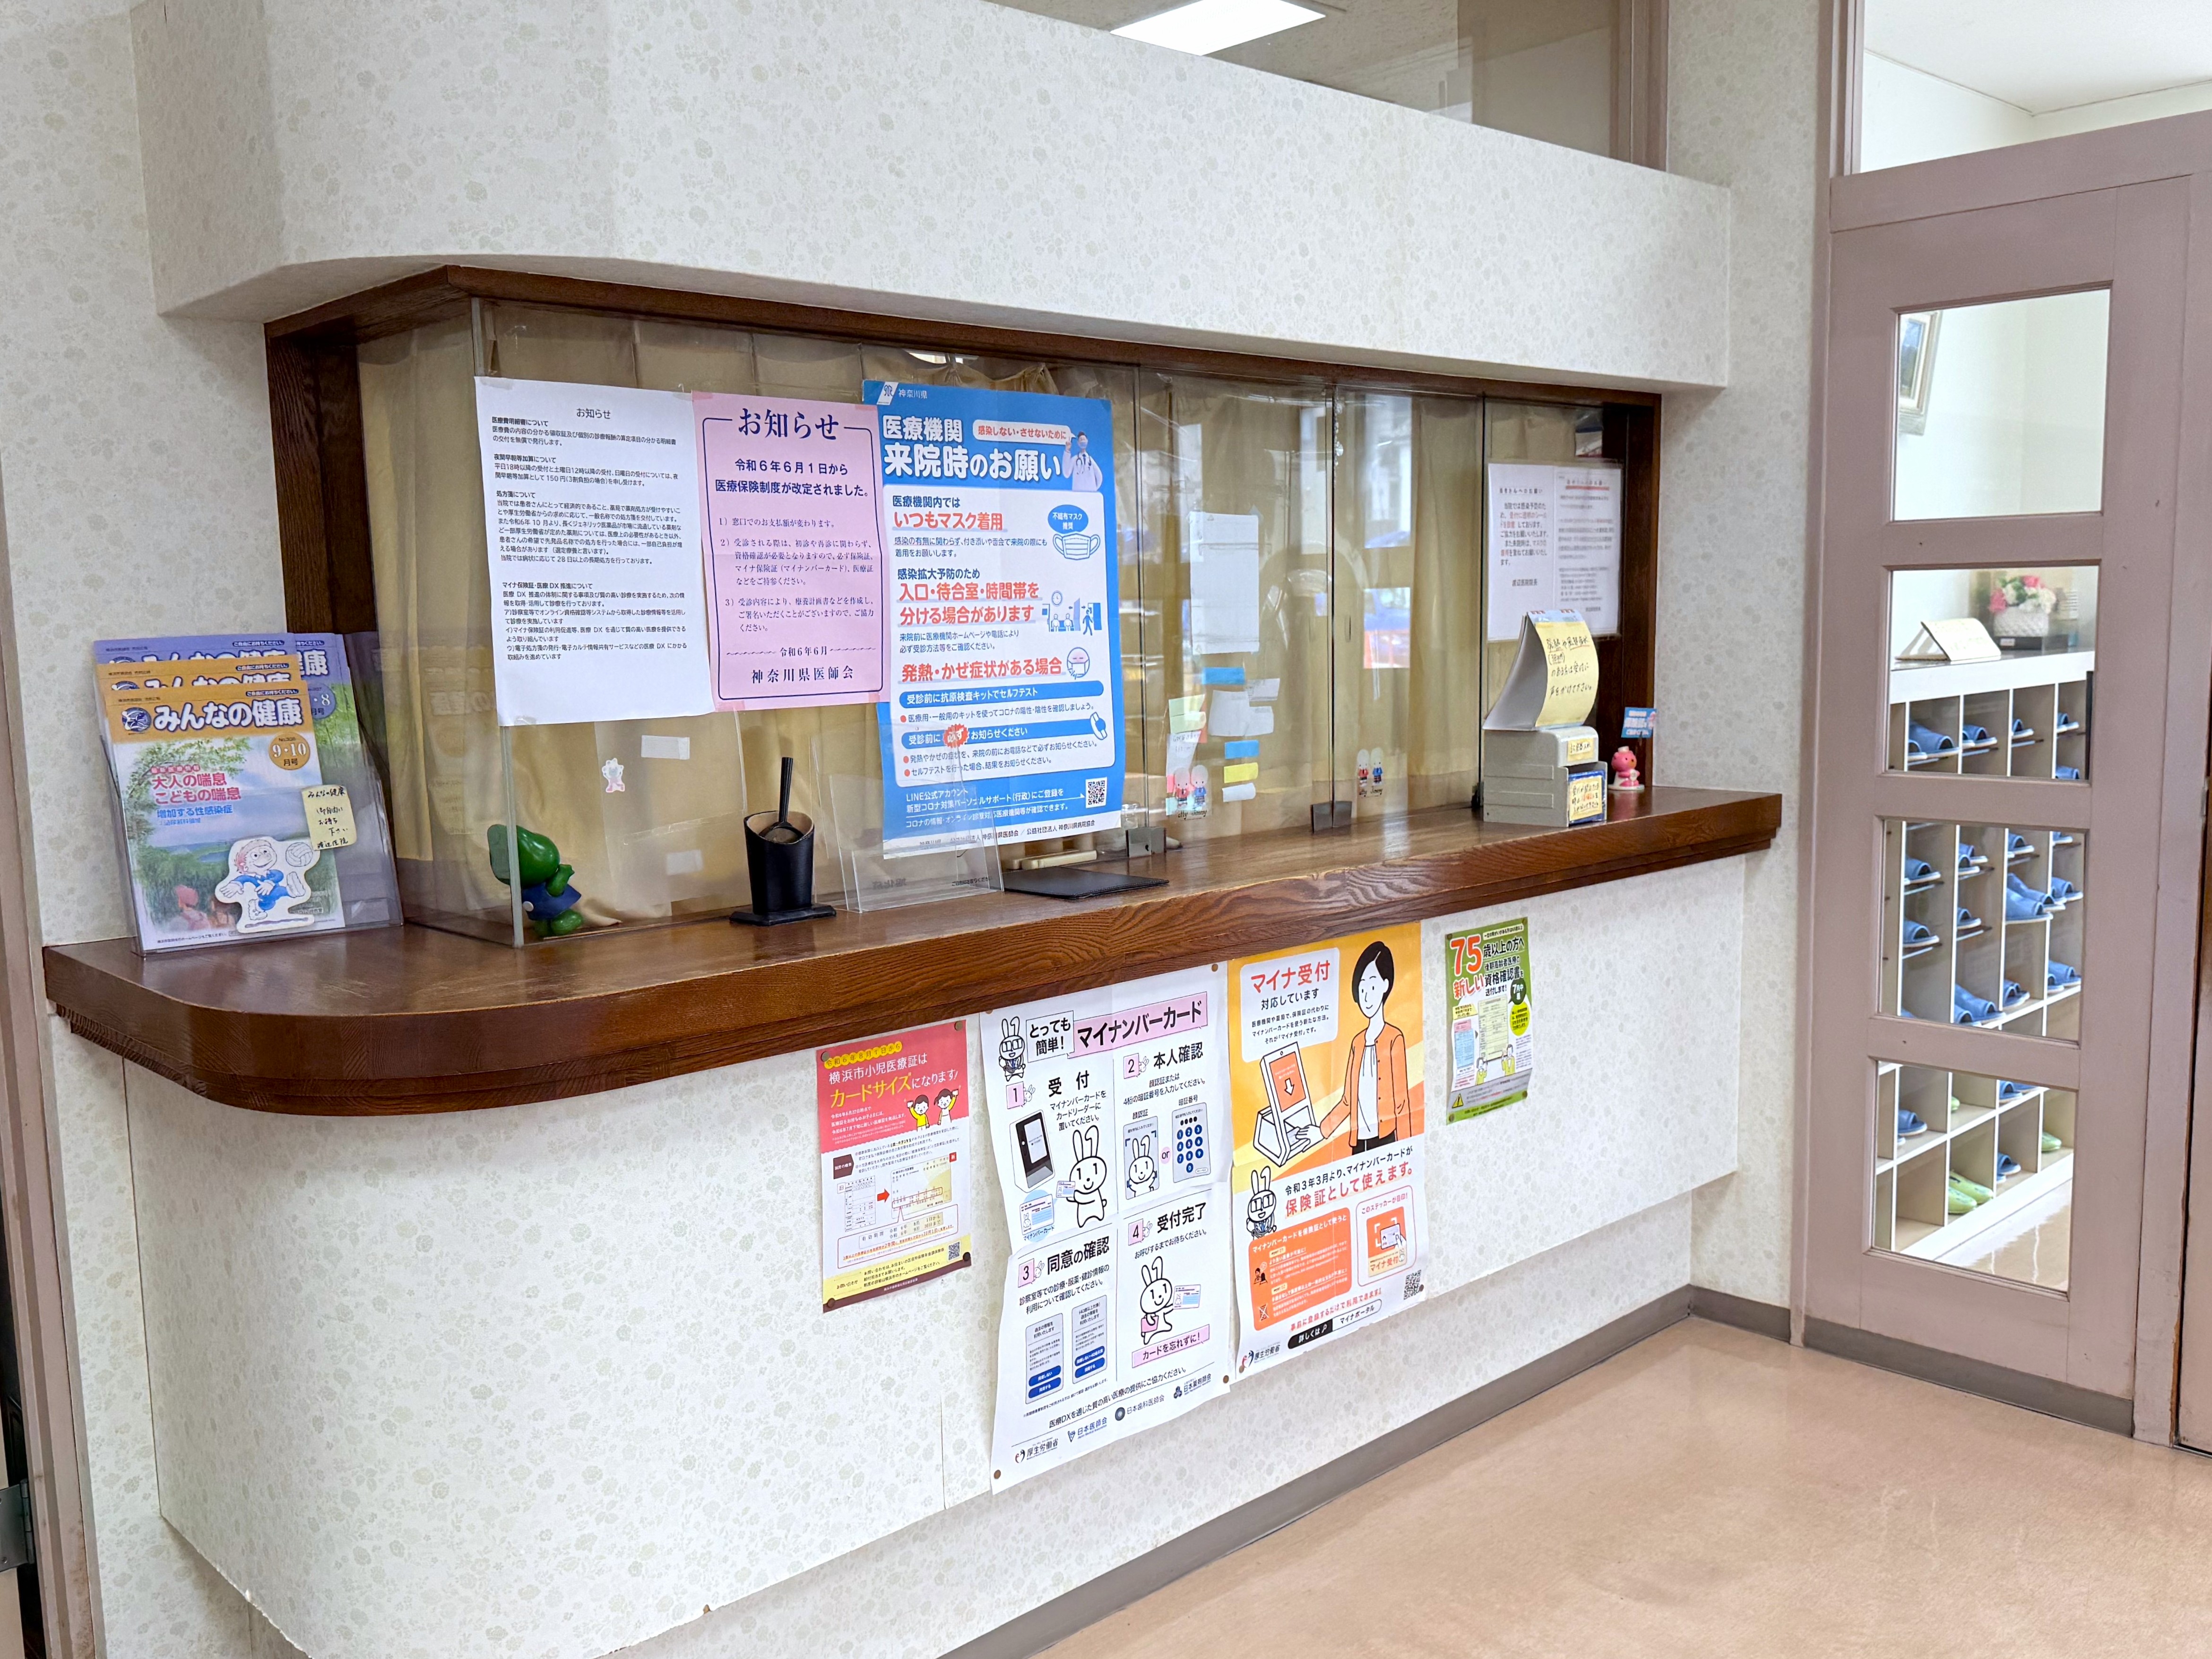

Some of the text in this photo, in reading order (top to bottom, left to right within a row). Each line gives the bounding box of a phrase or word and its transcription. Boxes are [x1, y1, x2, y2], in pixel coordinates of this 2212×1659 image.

[898, 389, 928, 399] 神奈川県
[492, 417, 548, 426] 医療費明細書について
[576, 408, 611, 419] お知らせ
[738, 408, 838, 440] お知らせ
[883, 415, 962, 442] 医療機関
[978, 425, 1066, 439] 感染しない・させないために
[884, 443, 1061, 481] 来院時のお願い
[716, 479, 868, 497] 医療保険制度が改定されました。
[893, 495, 960, 507] 医療機関内では
[895, 512, 1003, 530] いつもマスク着用
[1053, 512, 1082, 520] 不織布マスク
[894, 537, 1047, 547] 感染の有無に関わらず、付き添いや面会で来院の際にも
[895, 549, 957, 557] 着用をお願いします。
[736, 577, 806, 585] などをご持参ください。
[898, 568, 980, 579] 感染拡大予防のため
[899, 582, 1039, 601] 入口・待合室・時間帯を
[739, 610, 873, 618] ご署名いただくことがございますので、ご協力
[900, 606, 1034, 625] 分ける場合があります
[899, 630, 1019, 641] 来院前に医療機関ホームページや電話により
[900, 643, 995, 654] 必ず受診方法等をご確認ください。
[752, 665, 853, 683] 神奈川県医師会
[902, 657, 1062, 682] 発熱・かぜ症状がある場合
[907, 688, 1037, 704] 受診前に抗原検査キットでセルフテスト
[154, 699, 302, 731] みんなの健康
[908, 728, 1028, 745] 受診前に 必ず お知らせください
[284, 758, 298, 766] 月号
[153, 772, 227, 790] 大人の喘息
[156, 787, 241, 804] こどもの喘息
[907, 788, 968, 802] LINE公式アカウント
[157, 805, 233, 818] 増加する性感染症
[1451, 935, 1482, 975] 75
[1483, 937, 1524, 959] 歳以上の方へ
[1251, 960, 1331, 993] マイナ受付
[1261, 988, 1319, 1010] 対応しています
[1029, 1017, 1071, 1038] とっても
[1077, 1001, 1202, 1048] マイナンバーカード
[1153, 1042, 1203, 1069] 本人確認
[829, 1053, 927, 1085] 横浜市小児医療証は
[1128, 1059, 1134, 1073] 2
[1013, 1088, 1018, 1102] 1
[1050, 1090, 1106, 1111] マイナンバーカードを
[1179, 1095, 1198, 1106] 暗証番号
[1056, 1102, 1101, 1121] カードリーダーに
[1059, 1115, 1099, 1131] 置いてください。
[1285, 1145, 1413, 1196] 令和3年3月より、マイナンバーカードが
[1285, 1161, 1412, 1217] 保険証として使えます。
[1157, 1202, 1207, 1234] 受付完了
[1023, 1225, 1054, 1241] マイナンバーカード
[1132, 1224, 1139, 1238] 4
[1253, 1215, 1347, 1253] マイナンバーカードを保険証として使うと
[1135, 1230, 1207, 1259] お呼びするまでお待ちください。
[1047, 1236, 1109, 1275] 同意の確認
[1370, 1255, 1399, 1271] マイナ受付
[1023, 1265, 1029, 1280] 3
[1026, 1279, 1103, 1313] 利用について確認してください。
[1298, 1305, 1375, 1343] 詳しくは マイナポータル
[1127, 1395, 1165, 1415] 日本歯科医師会
[1077, 1417, 1107, 1436] 日本医師会
[1027, 1438, 1058, 1457] 厚生労働省
